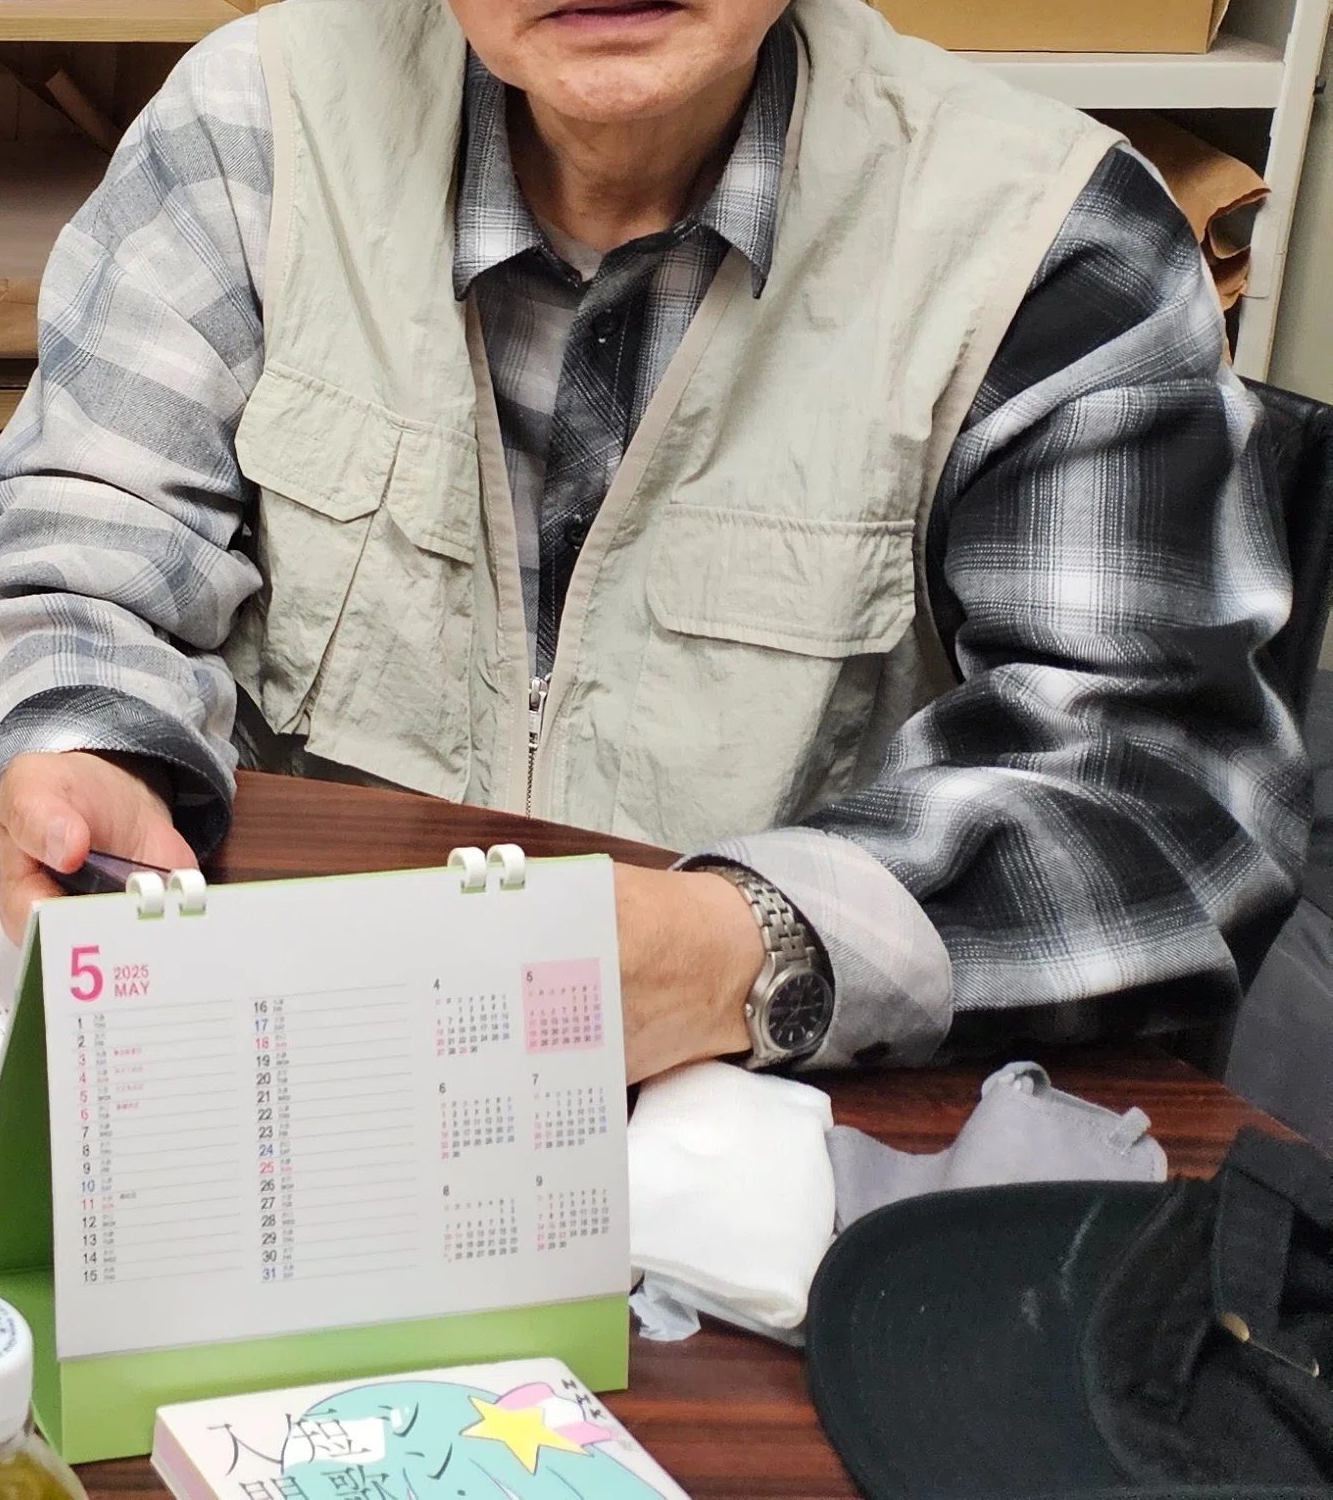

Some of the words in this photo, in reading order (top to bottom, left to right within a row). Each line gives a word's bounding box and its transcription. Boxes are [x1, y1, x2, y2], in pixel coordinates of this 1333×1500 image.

[69, 944, 105, 1003] 5
[113, 964, 150, 981] 2025
[113, 980, 151, 998] MAY
[252, 1001, 268, 1015] 16
[255, 1072, 272, 1086] 20
[257, 1109, 274, 1122] 22
[259, 1161, 275, 1175] 25
[81, 1179, 96, 1193] 10
[260, 1197, 276, 1210] 27
[81, 1216, 97, 1229] 12
[262, 1250, 278, 1263] 30
[82, 1269, 98, 1283] 15
[262, 1267, 277, 1281] 31
